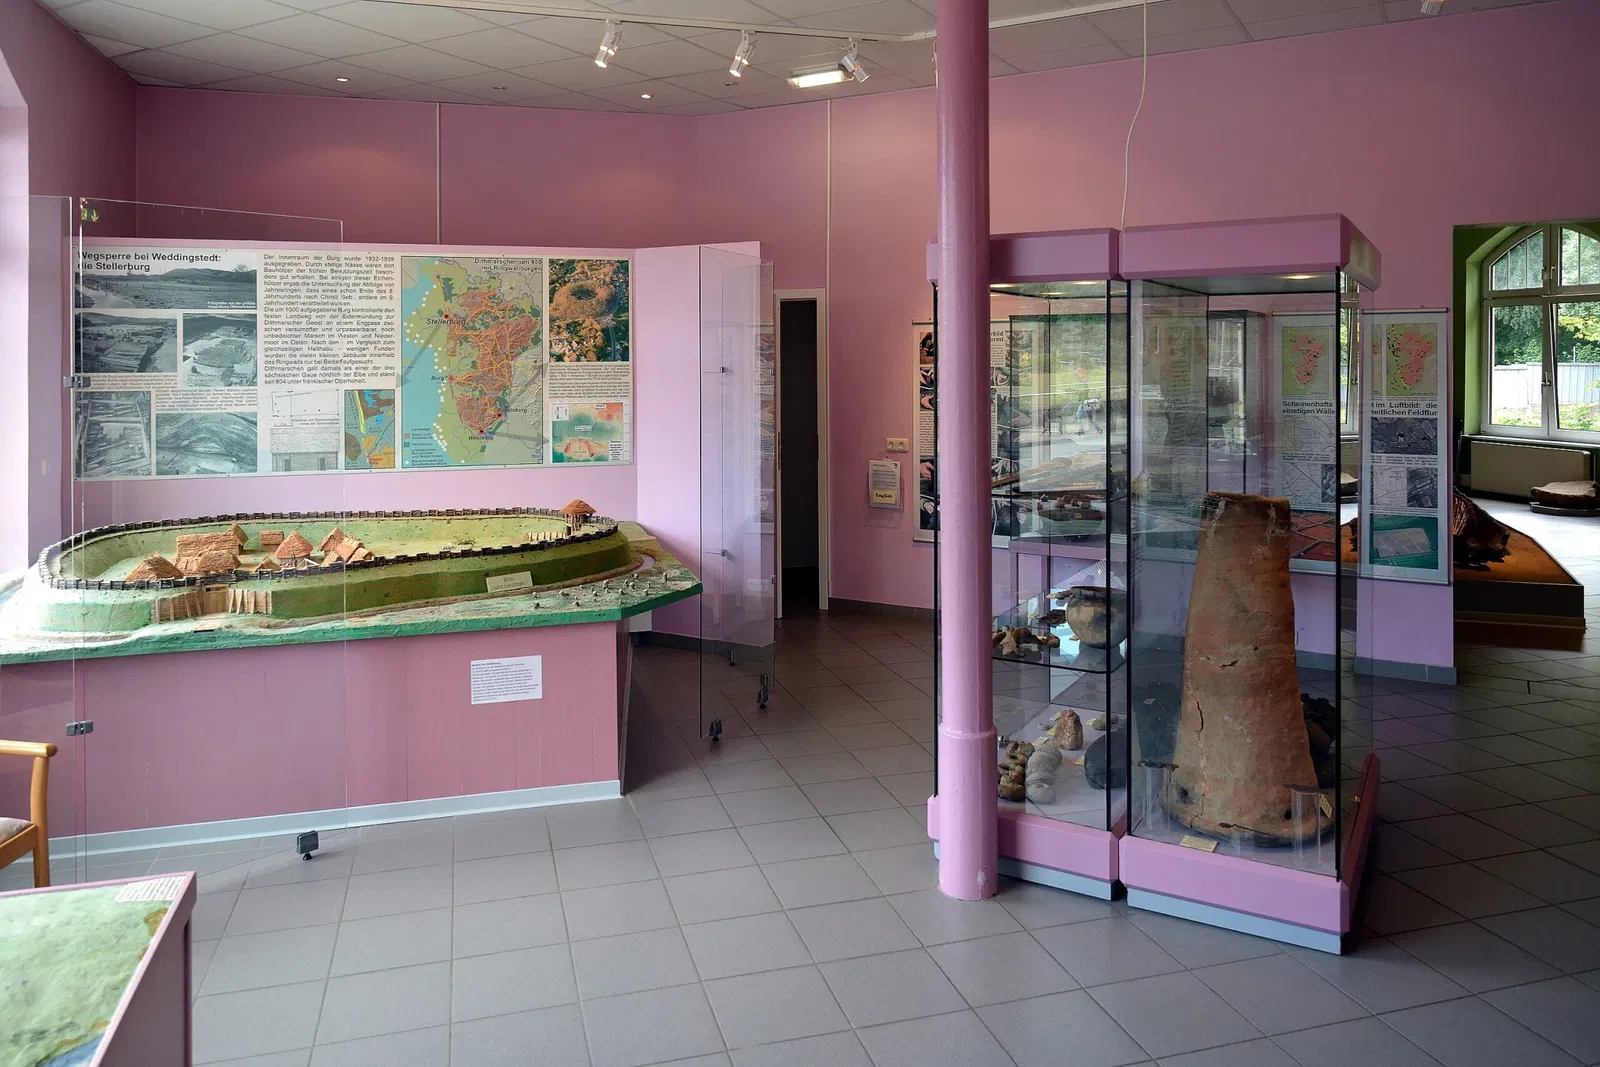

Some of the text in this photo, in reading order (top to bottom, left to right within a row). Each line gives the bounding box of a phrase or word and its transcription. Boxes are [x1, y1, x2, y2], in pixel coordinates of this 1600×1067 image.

[78, 252, 131, 261] Wegsperre
[152, 253, 221, 263] Weddingstedt:
[96, 262, 150, 272] Stellerburg
[426, 318, 466, 326] Stellerburg
